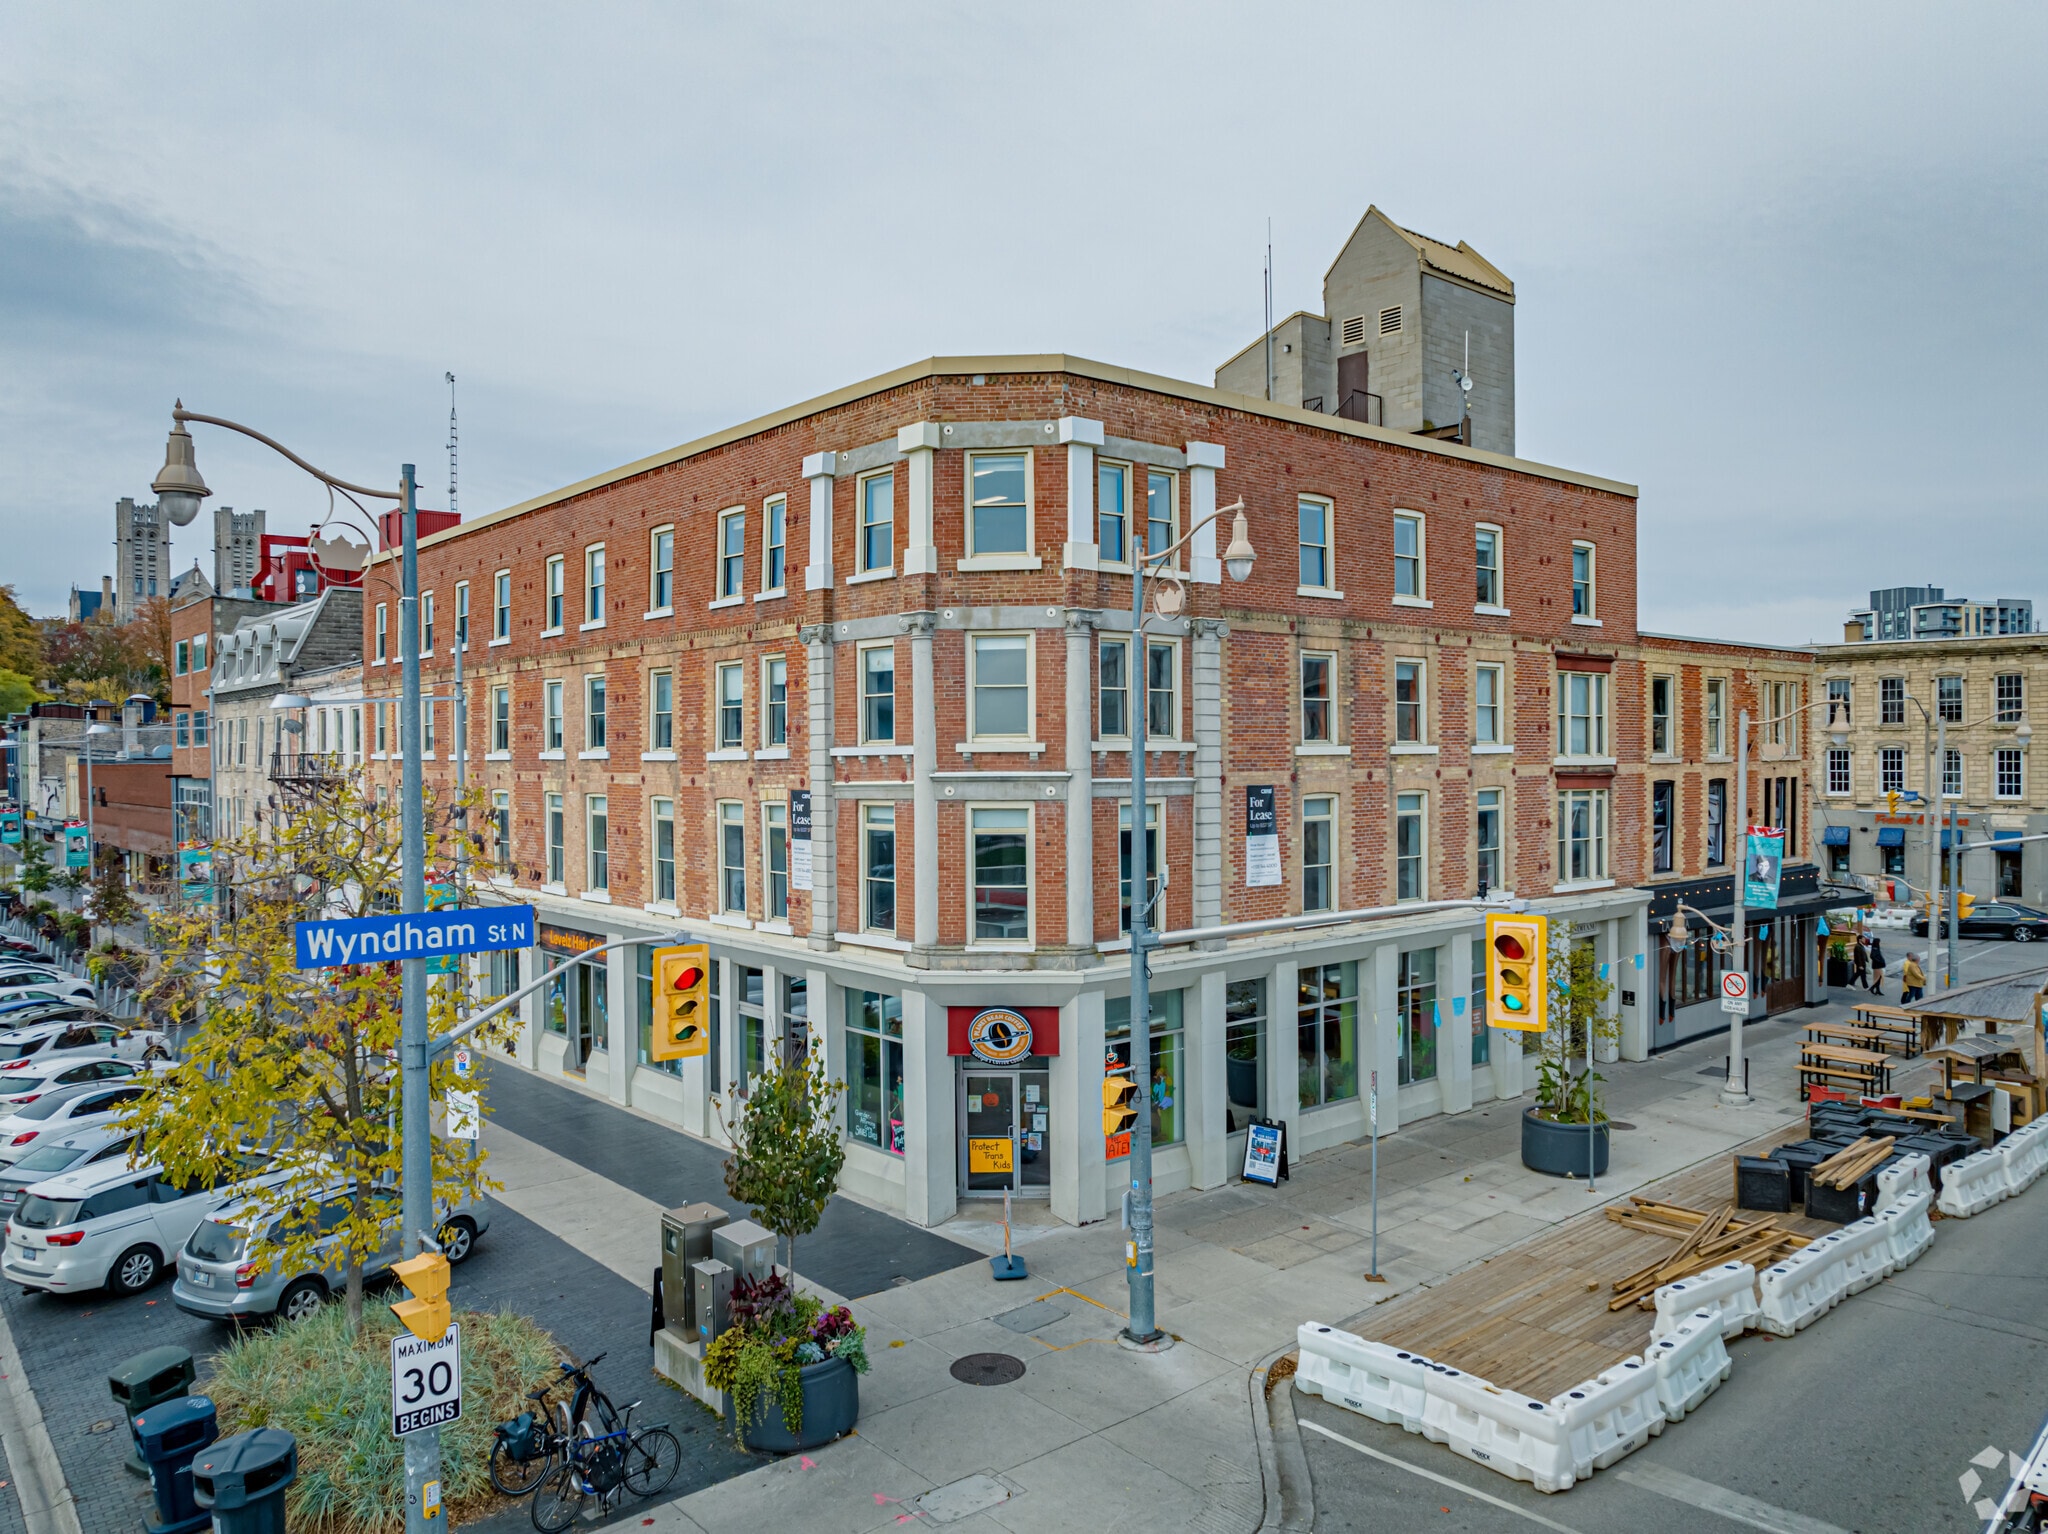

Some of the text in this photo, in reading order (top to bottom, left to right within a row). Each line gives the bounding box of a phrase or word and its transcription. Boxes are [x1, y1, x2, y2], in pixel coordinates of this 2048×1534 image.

[792, 801, 804, 812] For
[1249, 796, 1264, 808] For
[792, 813, 811, 825] Lease
[1249, 809, 1273, 821] Lease
[306, 921, 525, 965] Wyndham St N
[549, 929, 572, 949] Levelz
[572, 935, 589, 951] Hair
[973, 1013, 1025, 1037] PLANET BEAN COFFEE
[971, 1140, 1001, 1152] Protect
[983, 1151, 1004, 1160] Trans
[993, 1160, 1011, 1170] Kids
[398, 1334, 454, 1359] MAXIMUM
[401, 1361, 453, 1404] 30
[400, 1402, 455, 1432] BEGINS
